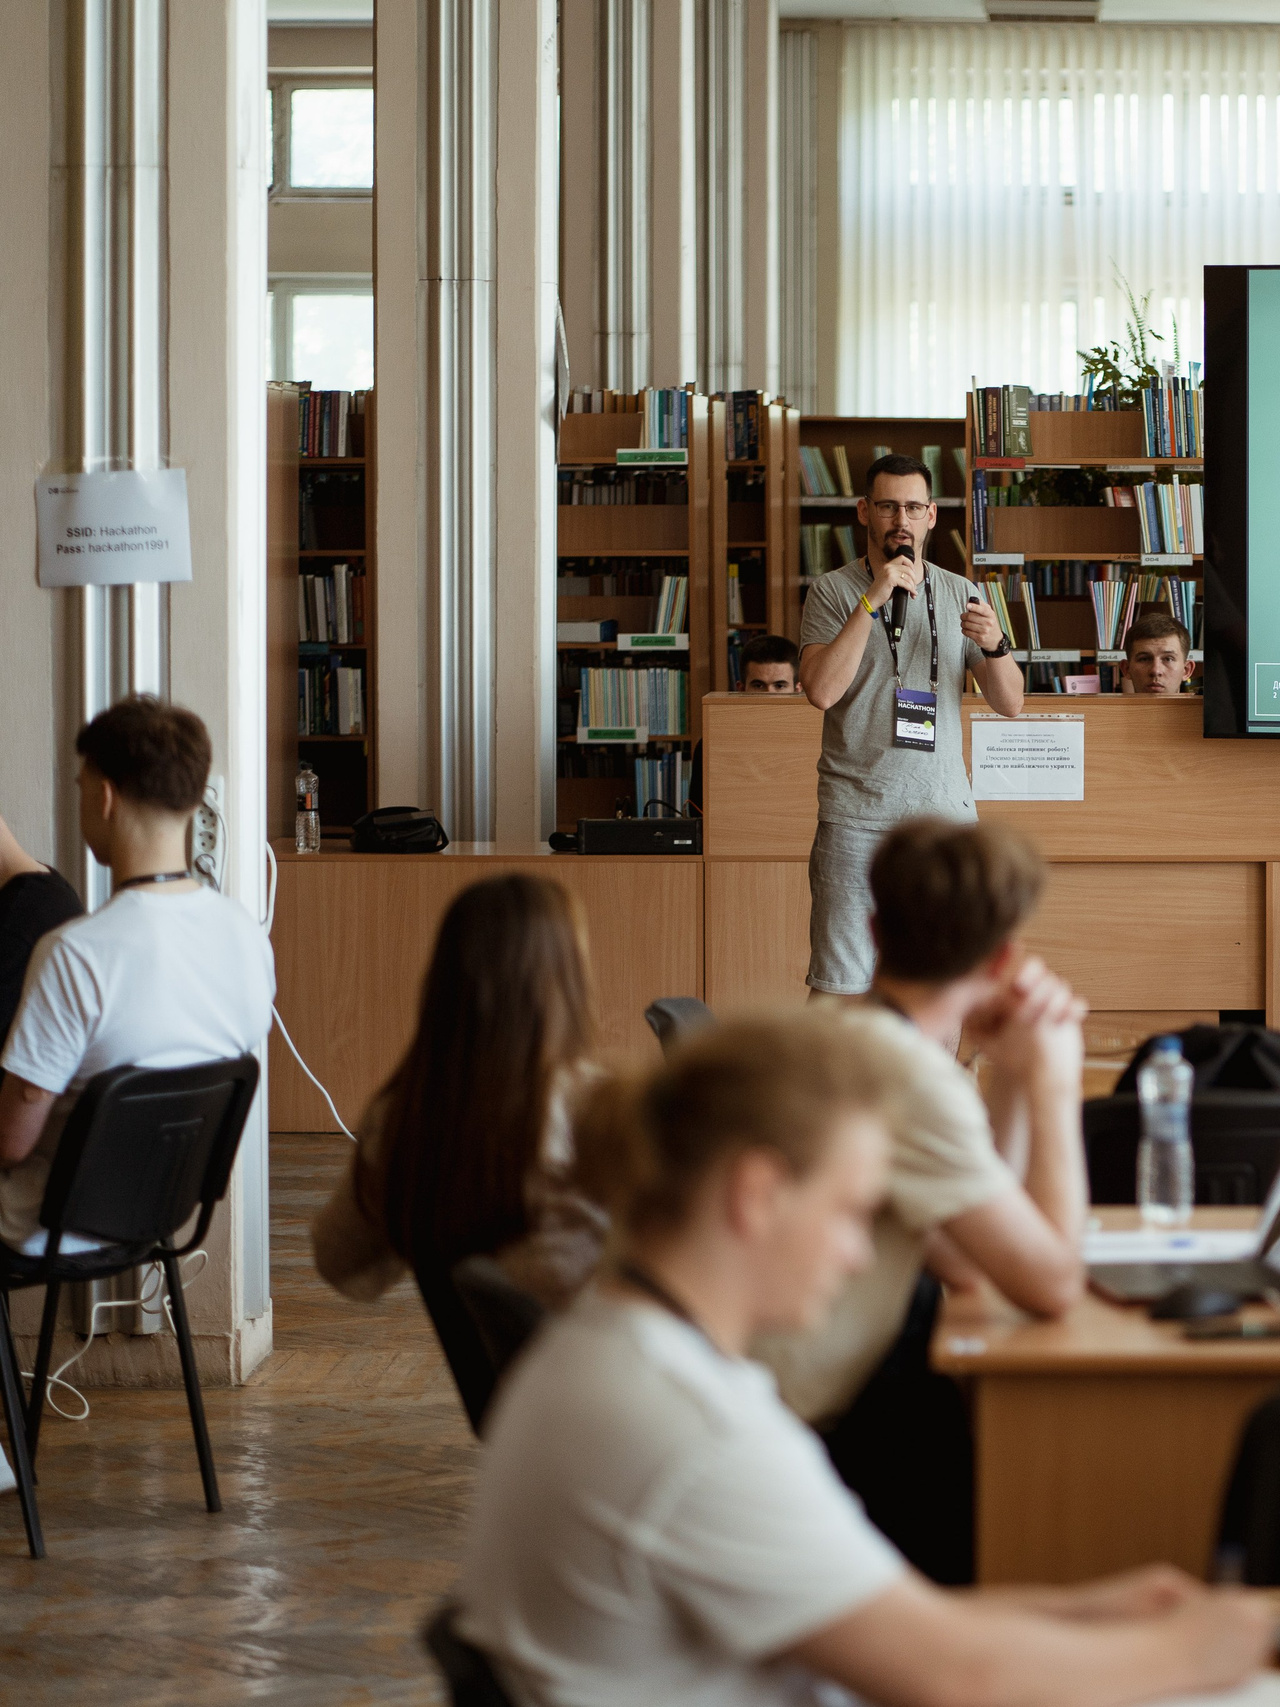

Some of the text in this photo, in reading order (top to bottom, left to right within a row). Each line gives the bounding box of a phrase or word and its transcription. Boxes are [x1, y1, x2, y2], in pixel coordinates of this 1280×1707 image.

[66, 525, 158, 538] SSID: Hackathon
[56, 540, 170, 555] Pass: hackathon1991
[897, 702, 936, 713] HACKATHON
